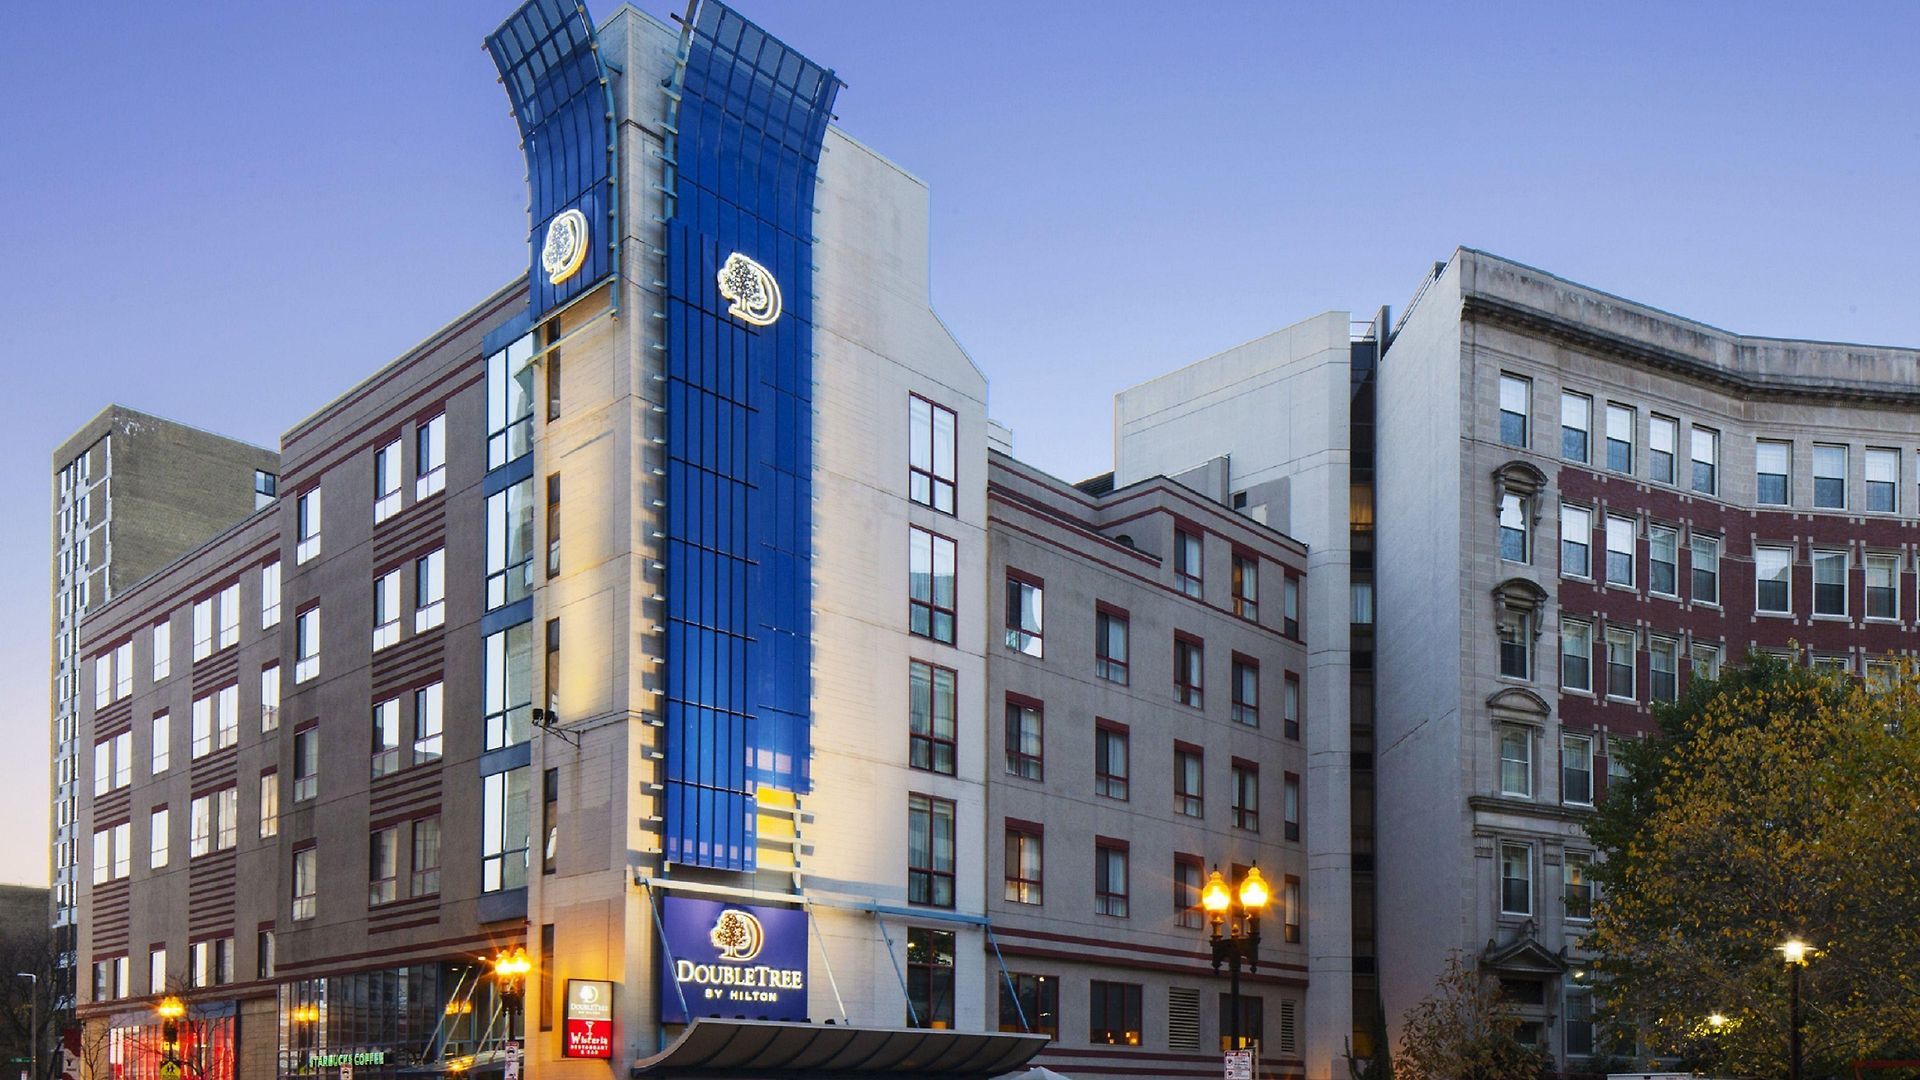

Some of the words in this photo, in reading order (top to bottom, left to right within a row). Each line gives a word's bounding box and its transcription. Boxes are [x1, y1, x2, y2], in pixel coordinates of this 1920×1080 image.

[676, 960, 803, 989] DOUBLETREE
[704, 988, 723, 999] BY
[730, 990, 778, 1002] HILTON
[309, 1054, 353, 1067] STARBUCKS
[354, 1052, 384, 1066] COFFEE
